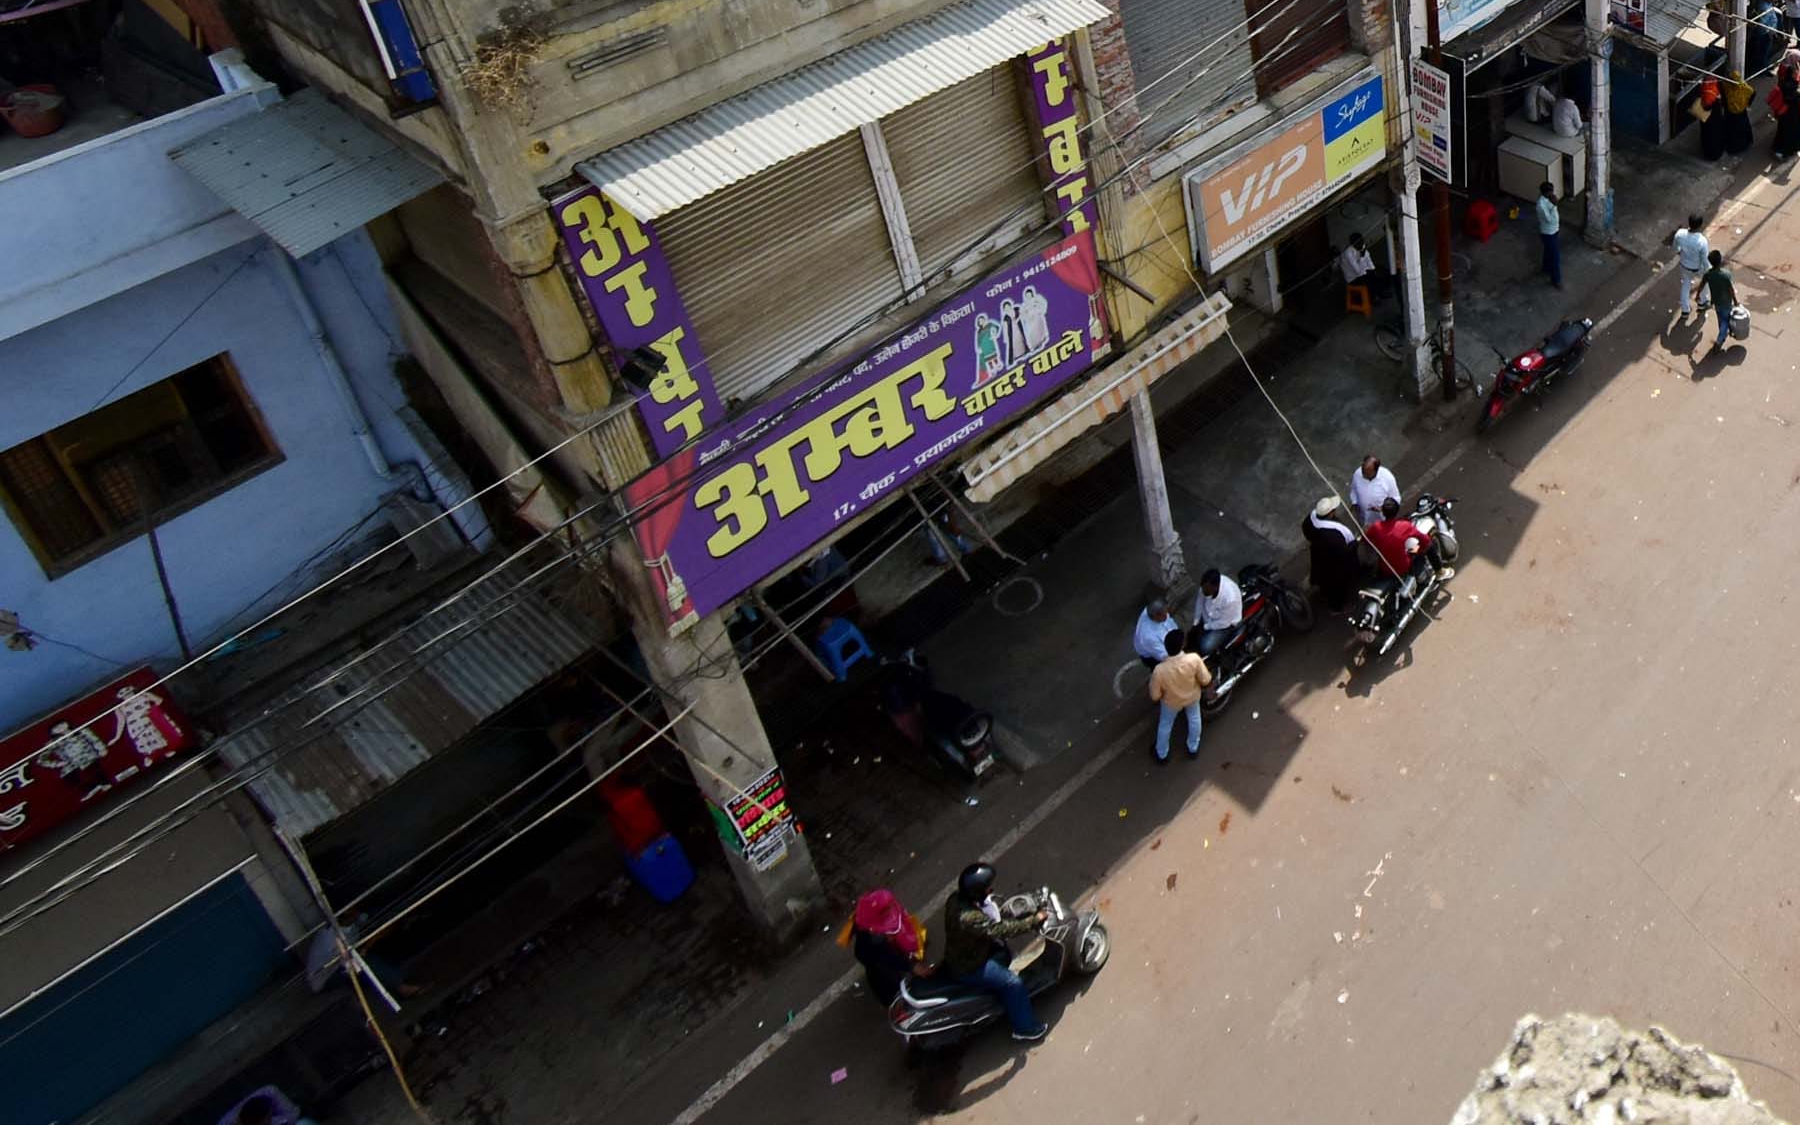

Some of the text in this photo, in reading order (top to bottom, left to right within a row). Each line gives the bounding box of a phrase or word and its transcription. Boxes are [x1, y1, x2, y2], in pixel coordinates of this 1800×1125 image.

[1412, 66, 1446, 97] BOMBAY
[961, 328, 1084, 416] चादर वाले
[694, 342, 958, 558] अम्बर
[913, 415, 986, 473] प्रयागराज
